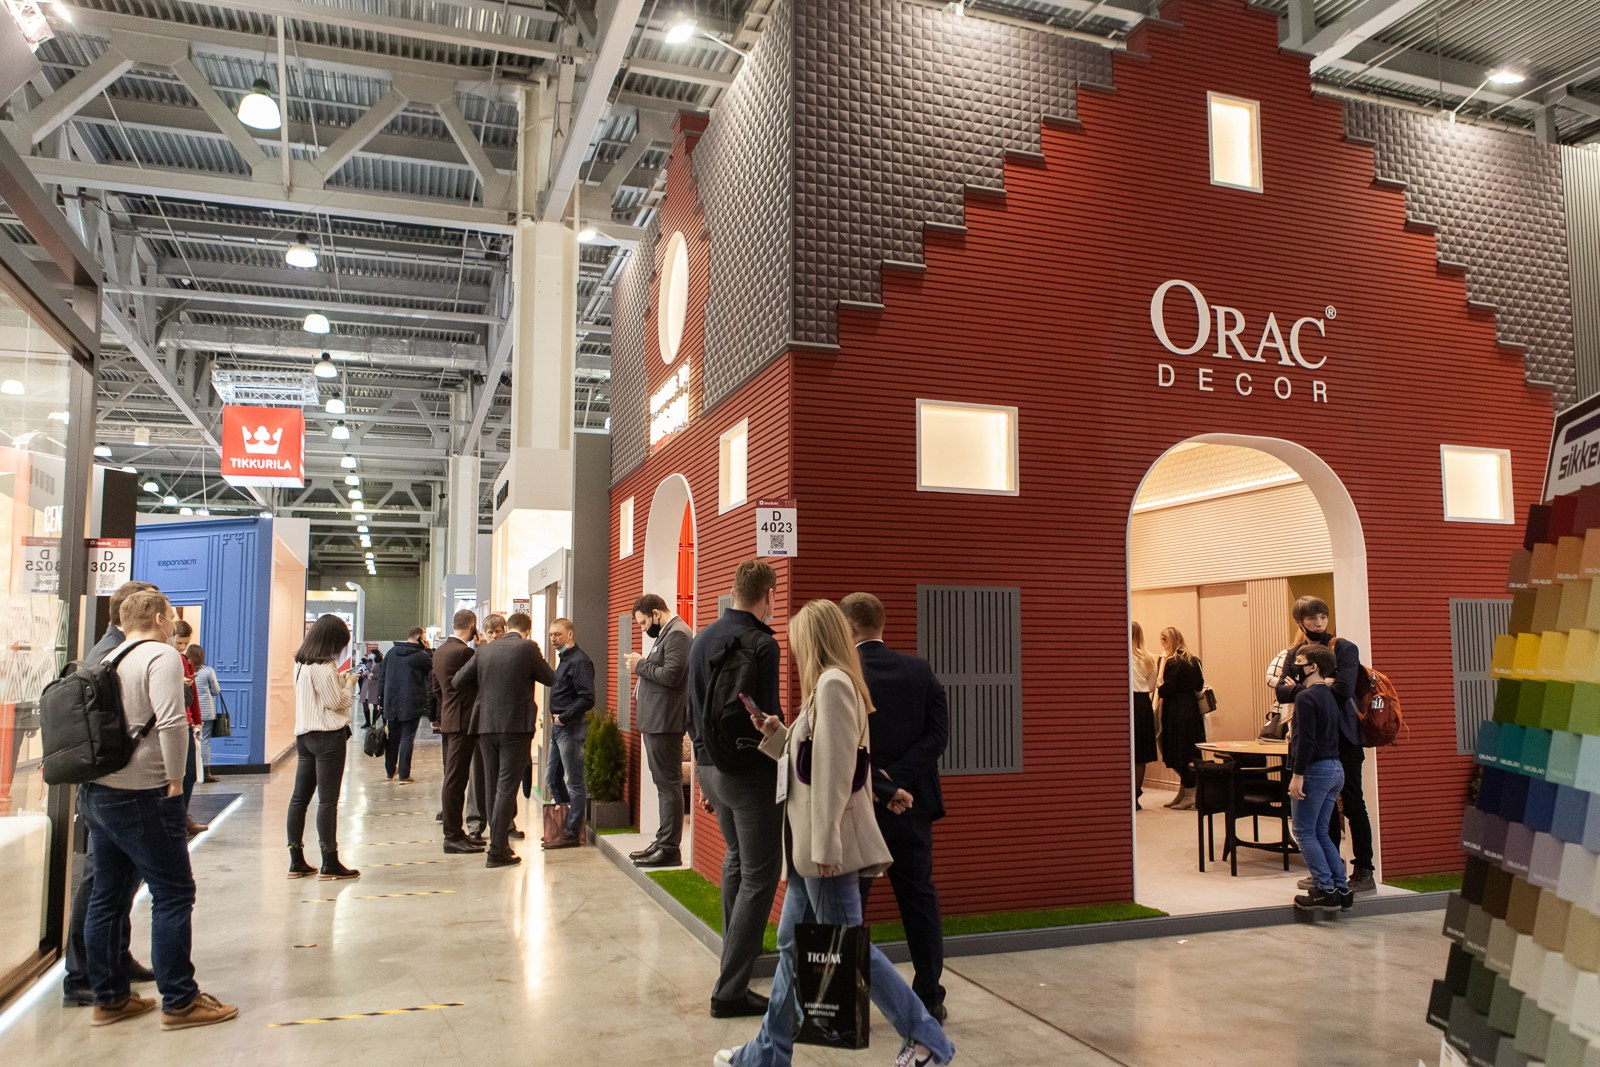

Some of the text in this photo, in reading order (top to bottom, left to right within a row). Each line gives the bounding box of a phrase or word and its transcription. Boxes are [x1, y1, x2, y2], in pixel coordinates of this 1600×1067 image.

[1150, 279, 1328, 369] ORAC
[1158, 363, 1328, 403] DECOR
[230, 457, 292, 470] TIKKURILA
[1558, 440, 1600, 481] sikke
[772, 510, 782, 521] D
[761, 521, 793, 533] 4023
[104, 551, 114, 561] D
[90, 561, 126, 573] 3025
